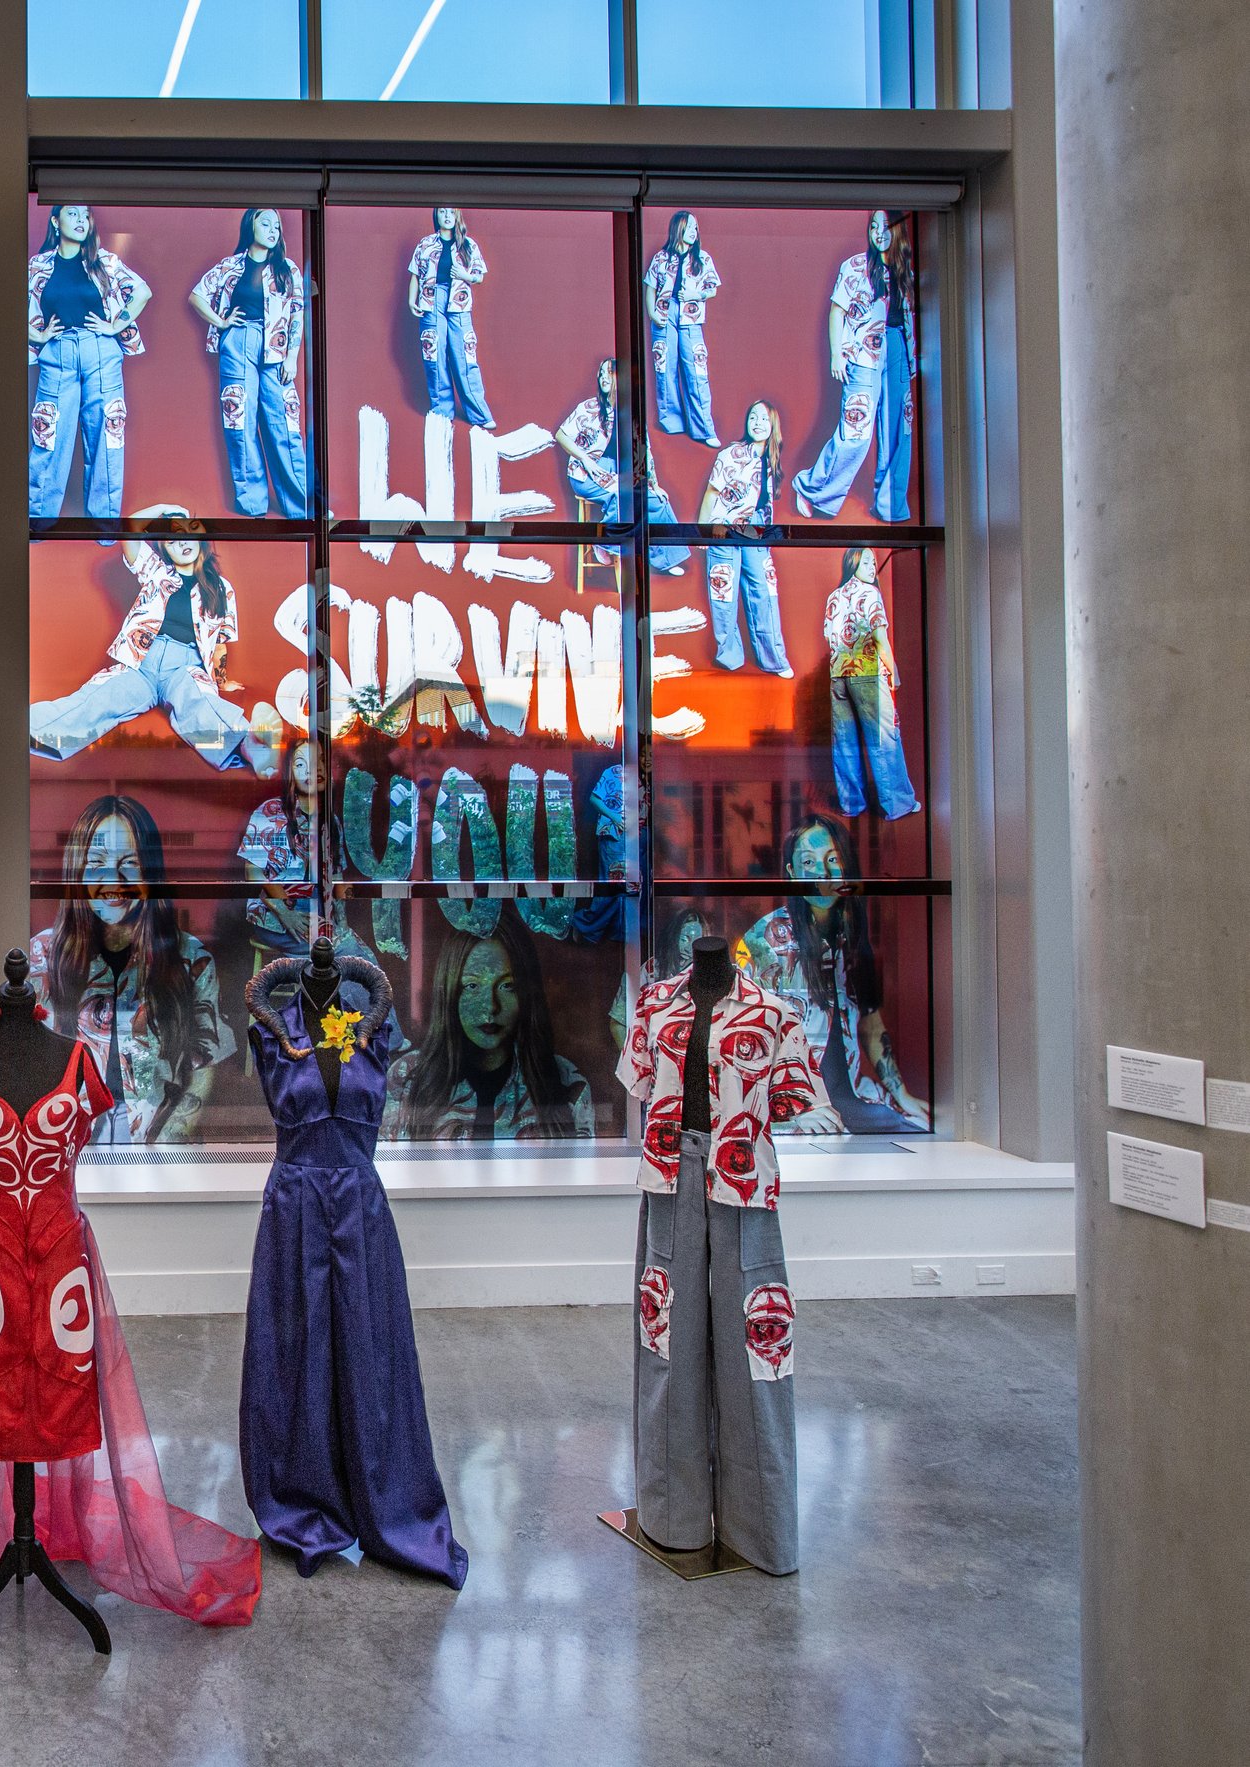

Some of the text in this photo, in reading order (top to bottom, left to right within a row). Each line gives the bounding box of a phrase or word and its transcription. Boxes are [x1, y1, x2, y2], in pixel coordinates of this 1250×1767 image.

[357, 404, 556, 584] WE
[273, 583, 708, 750] SURVIVE
[343, 763, 582, 961] YOU
